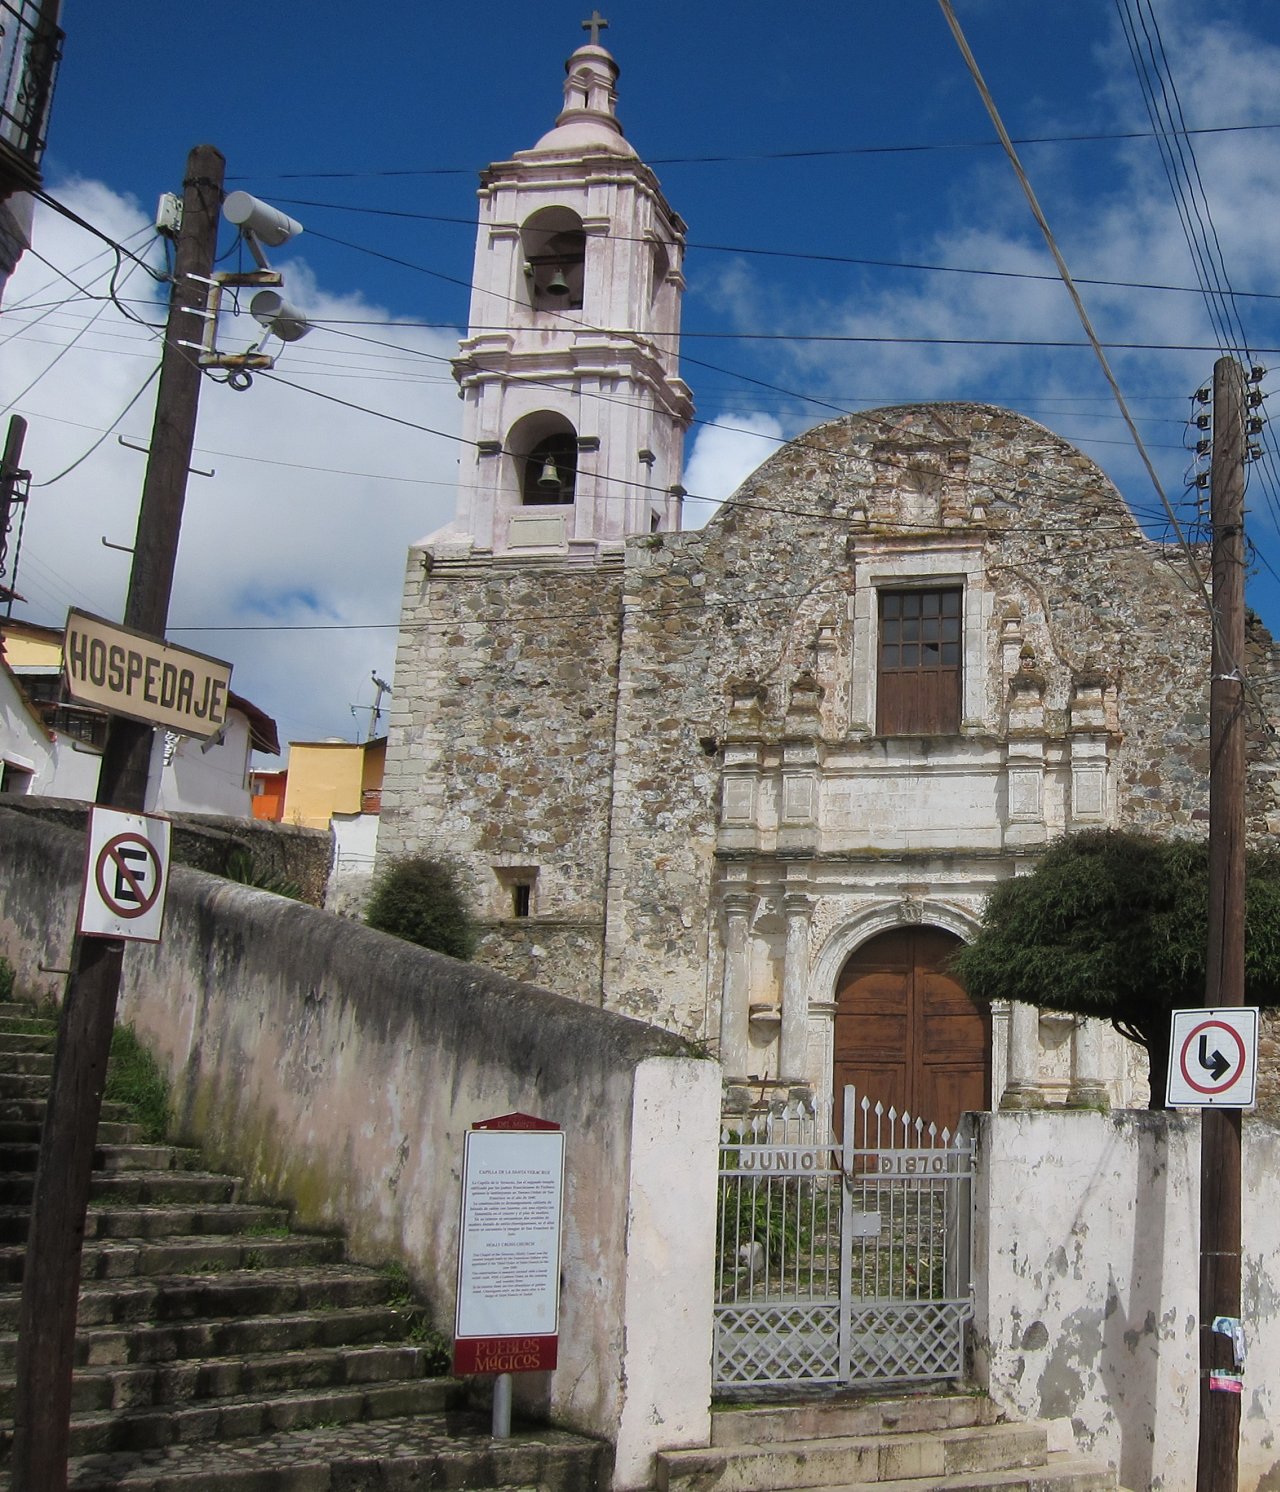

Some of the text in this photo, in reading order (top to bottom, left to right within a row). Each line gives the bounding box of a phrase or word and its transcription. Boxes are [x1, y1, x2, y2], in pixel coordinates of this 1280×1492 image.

[70, 631, 226, 724] HOSPEDAJE
[115, 847, 147, 902] E
[743, 1151, 814, 1170] JUNIO
